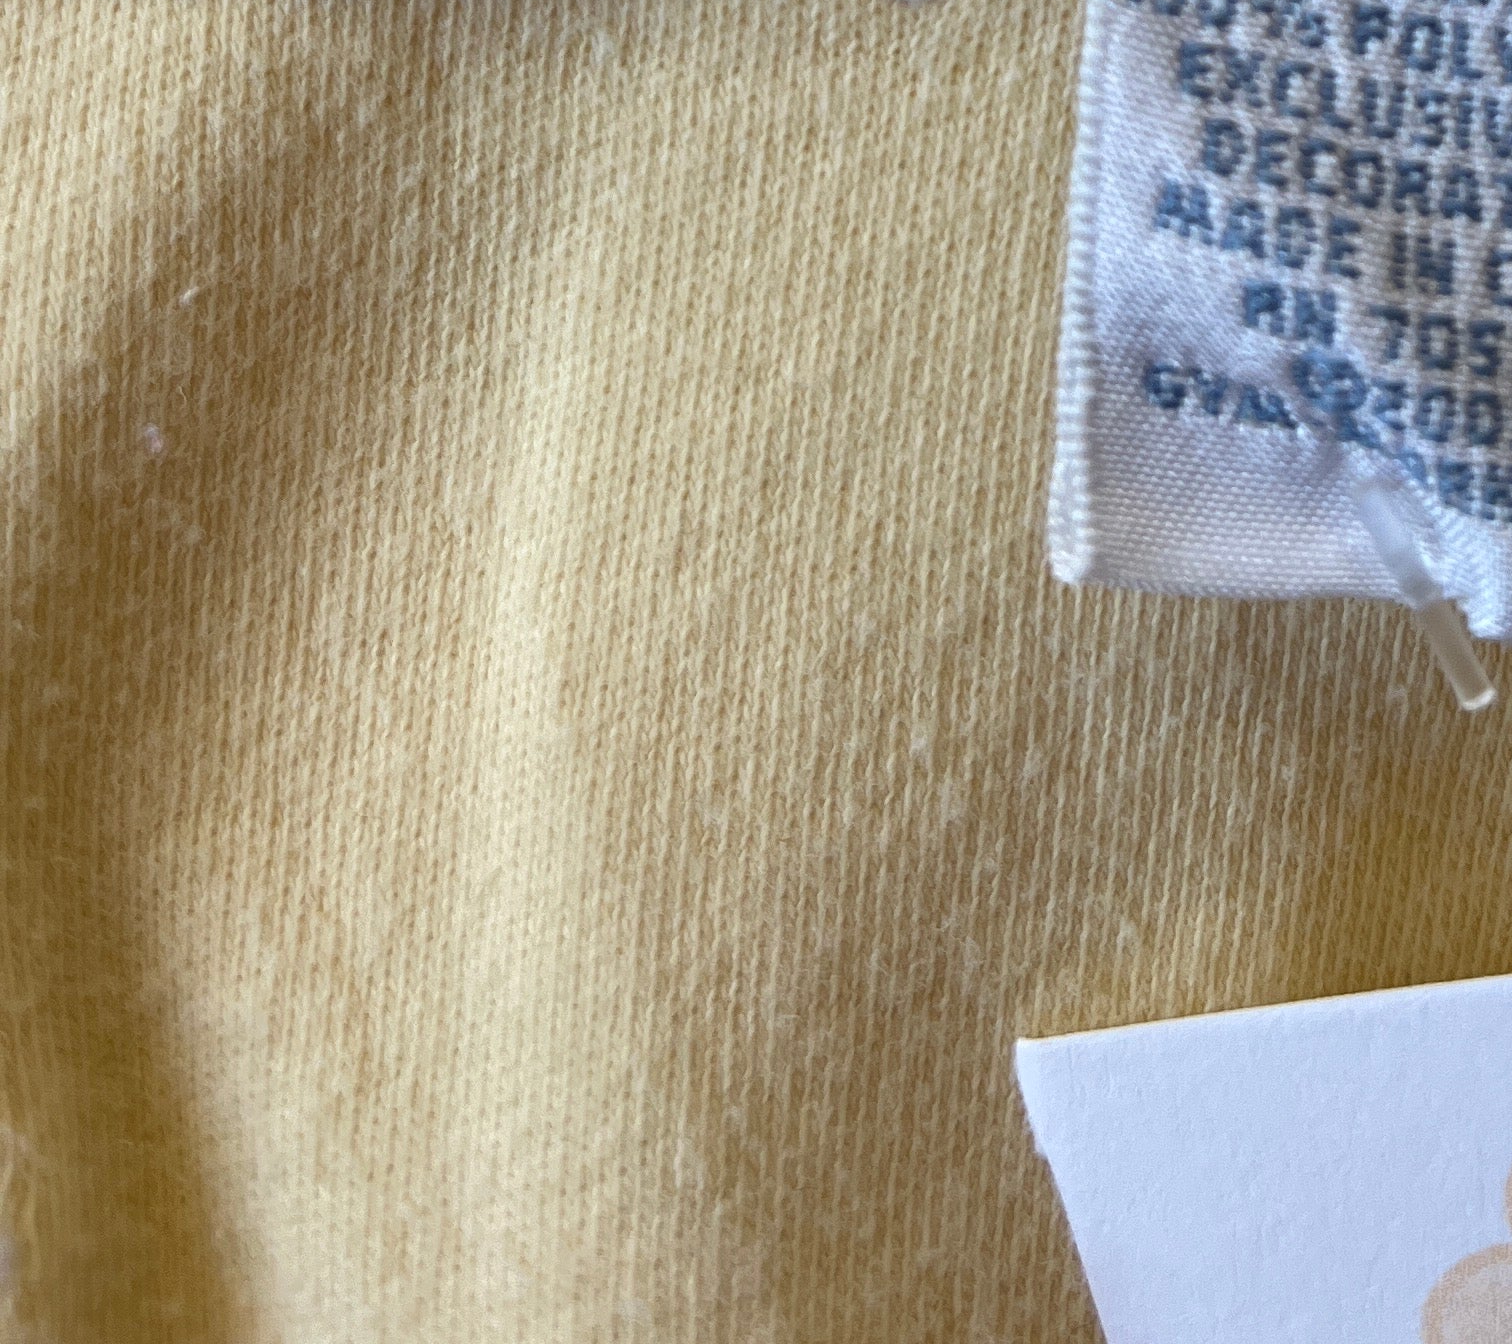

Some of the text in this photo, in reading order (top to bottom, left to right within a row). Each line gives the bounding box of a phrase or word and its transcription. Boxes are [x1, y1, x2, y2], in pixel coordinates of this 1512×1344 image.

[1153, 178, 1362, 280] MADE
[1391, 230, 1454, 297] IN
[1243, 282, 1336, 346] RN
